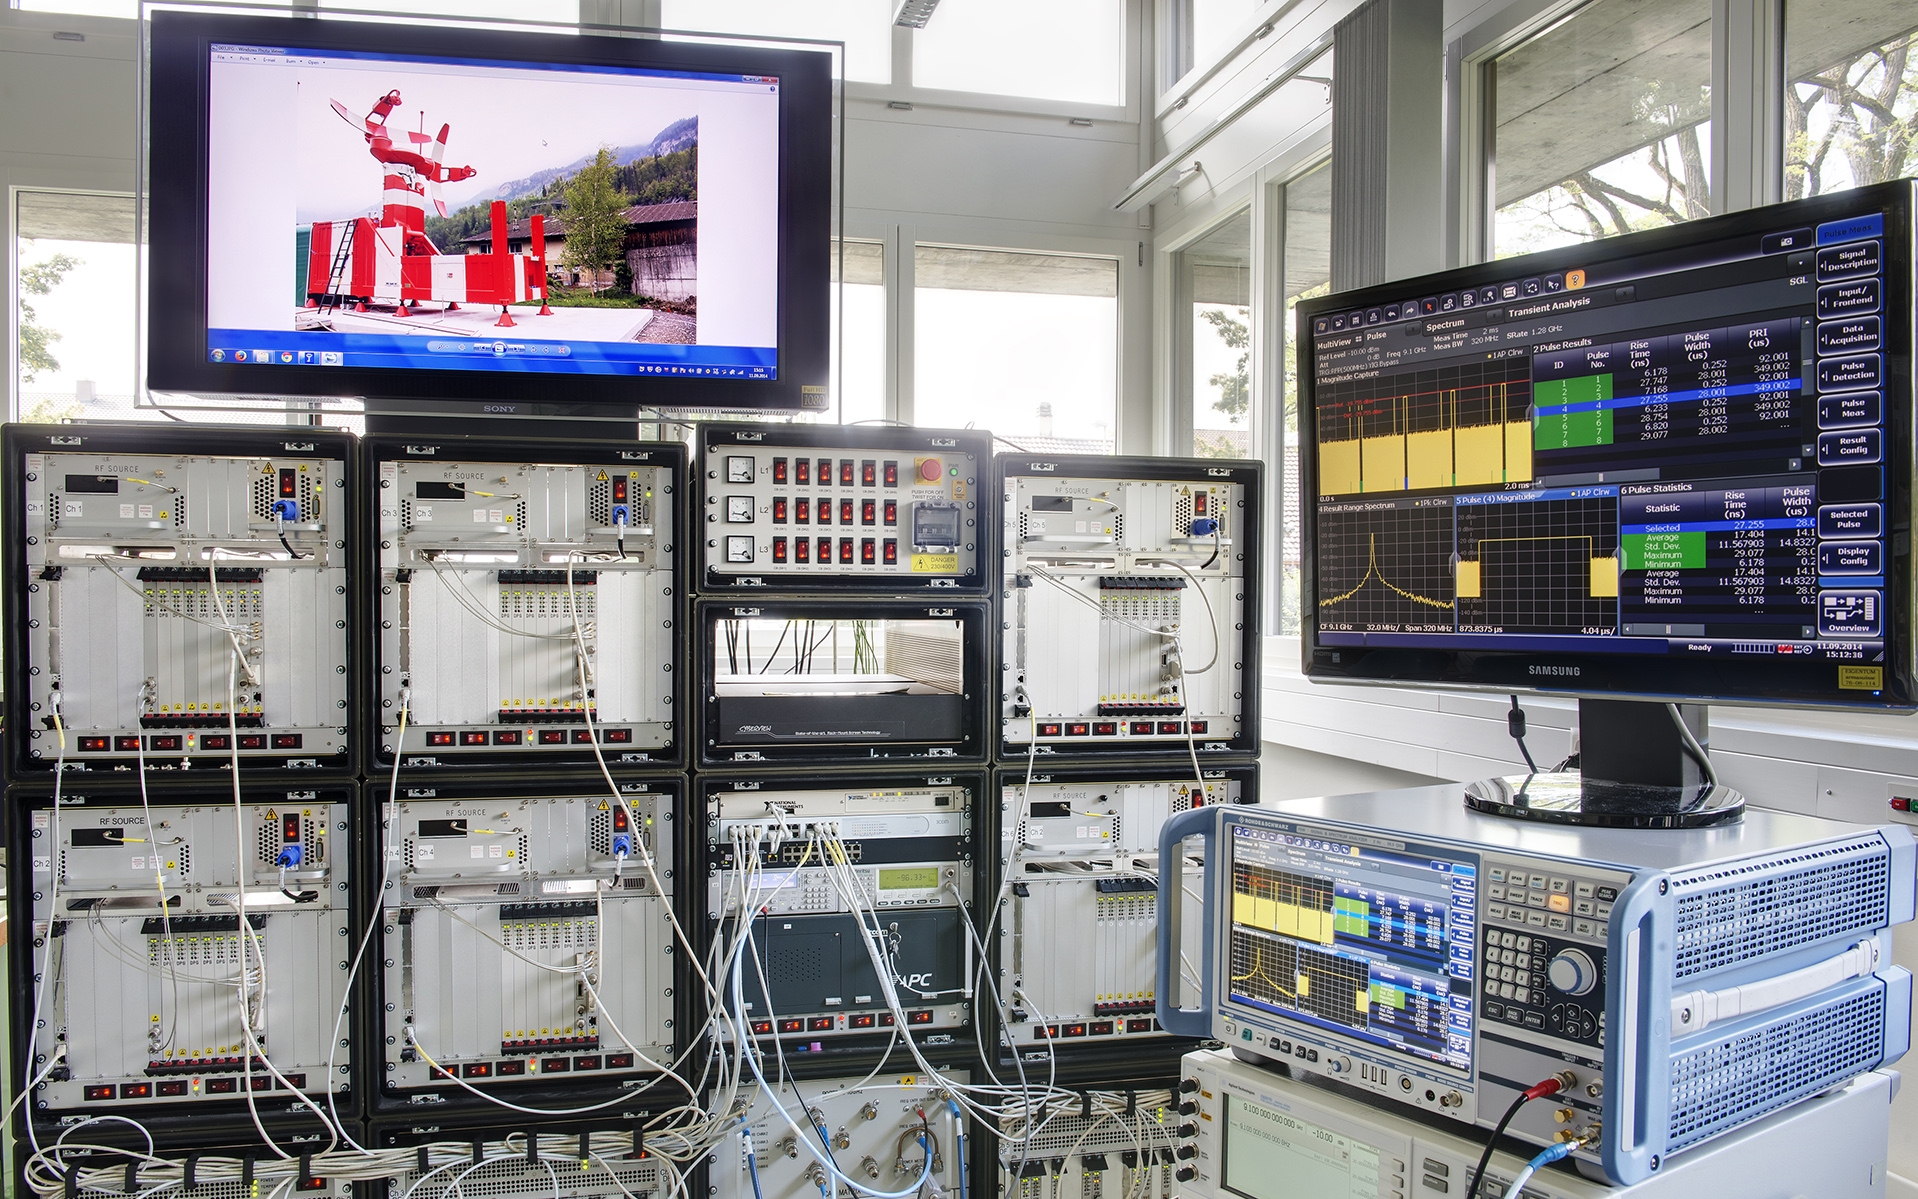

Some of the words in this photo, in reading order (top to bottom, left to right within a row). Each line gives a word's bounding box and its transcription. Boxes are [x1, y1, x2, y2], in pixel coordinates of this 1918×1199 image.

[1840, 249, 1866, 260] Signal
[1828, 258, 1877, 271] Description
[1790, 277, 1808, 285] SGL
[1839, 286, 1867, 297] Input/
[1834, 296, 1873, 307] Frontend
[1509, 304, 1550, 317] Transient
[1552, 297, 1590, 310] Analysis
[1427, 320, 1464, 331] Spectrum
[1843, 325, 1863, 333] Data
[1367, 332, 1386, 340] Pulse
[1507, 331, 1528, 339] SRate
[1532, 327, 1546, 335] 1.28
[1685, 333, 1709, 342] Pulse
[1749, 328, 1768, 338] PRI
[1748, 338, 1769, 349] (us)
[1830, 334, 1877, 345] Acquisition
[1317, 339, 1351, 350] MultiView
[1540, 343, 1561, 351] Pulse
[1563, 338, 1592, 349] Results
[1684, 341, 1711, 351] Width
[1588, 352, 1609, 360] Pulse
[1688, 350, 1708, 361] (us)
[1630, 359, 1649, 369] (ns)
[1644, 367, 1668, 376] 6.178
[1833, 371, 1874, 381] Detection
[1321, 373, 1352, 384] Magnitude
[1354, 370, 1379, 379] Capture
[1640, 376, 1667, 386] 27.747
[1645, 386, 1668, 394] 7.168
[804, 394, 825, 406] 1080
[1640, 394, 1668, 404] 27.255
[1645, 404, 1668, 413] 6.233
[1641, 413, 1668, 422] 28.754
[1645, 422, 1668, 431] 6.820
[1641, 431, 1668, 440] 29.077
[1840, 436, 1866, 444] Result
[1840, 446, 1868, 454] Config
[1654, 483, 1692, 492] Statistics
[1784, 488, 1810, 496] Pulse
[1463, 496, 1481, 504] Pulse
[1483, 495, 1494, 504] (4)
[1496, 493, 1535, 502] Magnitude
[1725, 491, 1745, 499] Rise
[1724, 501, 1746, 509] Time
[1783, 497, 1811, 506] Width
[1344, 503, 1364, 511] Range
[1365, 502, 1395, 510] Spectrum
[1646, 504, 1680, 513] Statistic
[1725, 510, 1745, 519] (ns)
[1786, 507, 1807, 517] (us)
[1831, 510, 1868, 518] Selected
[1646, 524, 1680, 532] Selected
[1734, 521, 1764, 529] 27.255
[1647, 534, 1679, 542] Average
[1735, 530, 1764, 538] 17.404
[1645, 542, 1660, 550] Std.
[1719, 540, 1764, 548] 11.567903
[1734, 549, 1764, 557] 29.077
[1838, 548, 1869, 556] Display
[1840, 558, 1868, 566] Config
[1829, 624, 1869, 632] Overview
[1688, 644, 1711, 652] Ready
[1529, 666, 1580, 676] SAMSUNG
[112, 817, 144, 825] SOURCE
[900, 974, 932, 987] APC
[1525, 1016, 1540, 1024] ENTER
